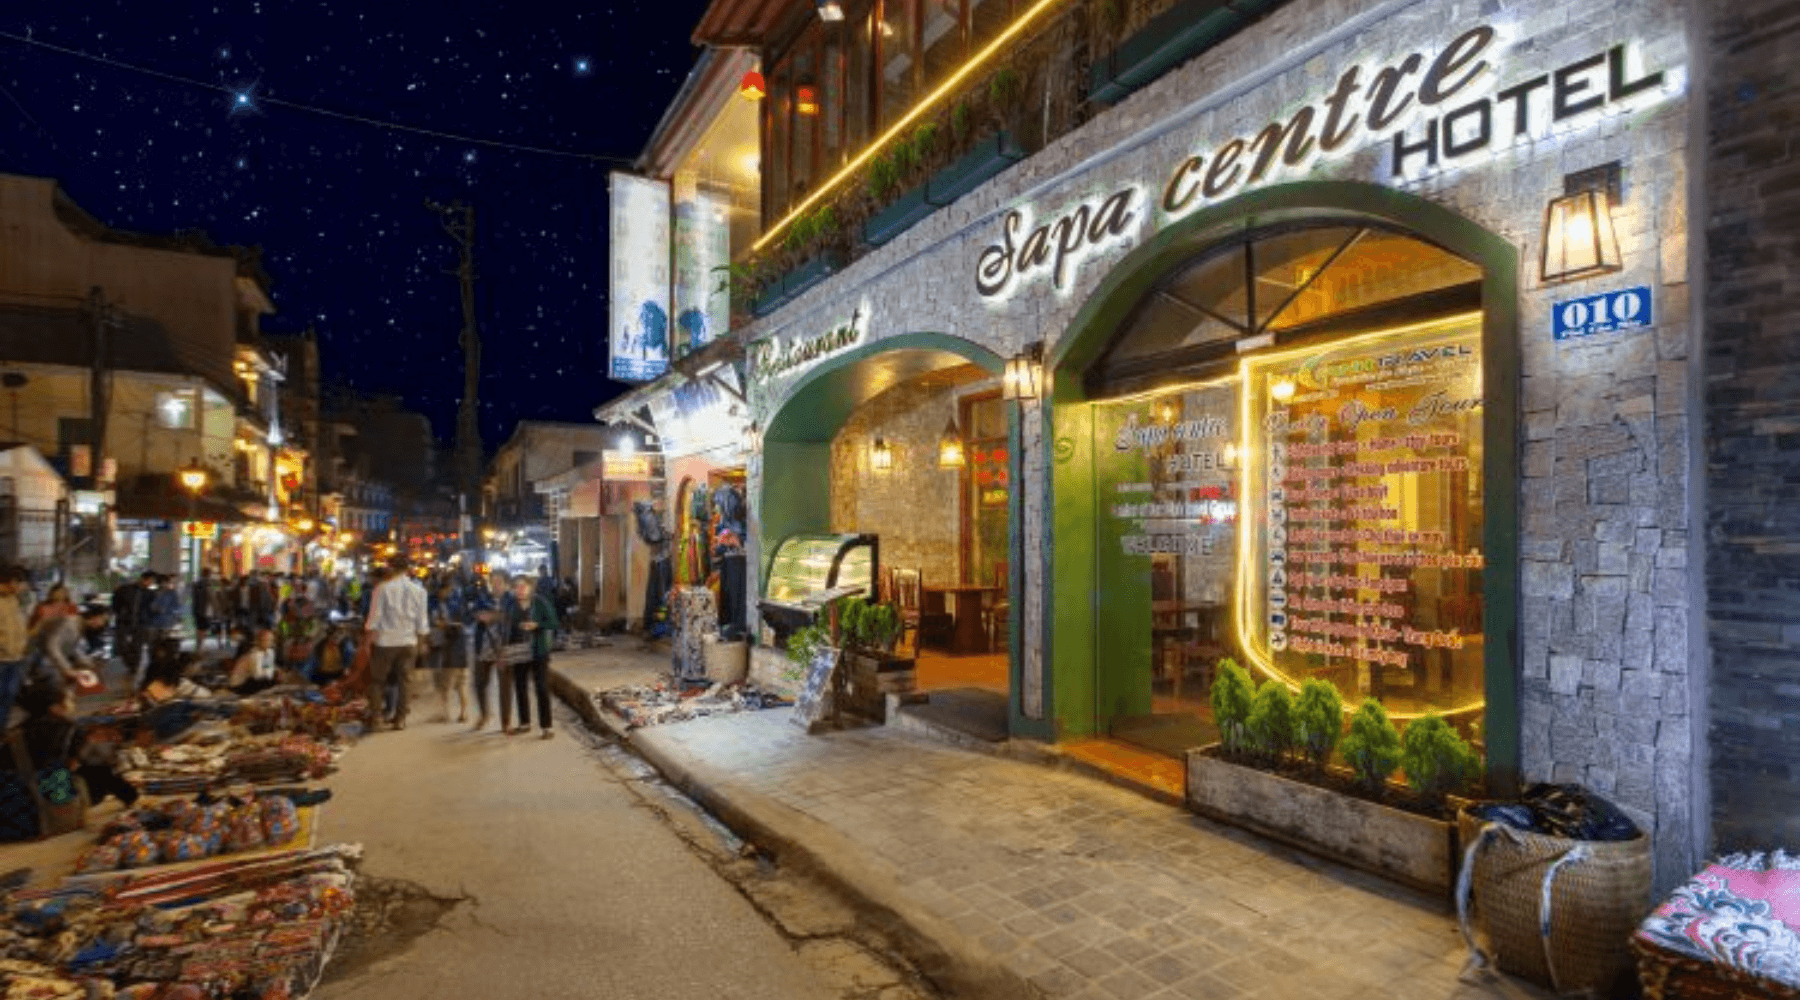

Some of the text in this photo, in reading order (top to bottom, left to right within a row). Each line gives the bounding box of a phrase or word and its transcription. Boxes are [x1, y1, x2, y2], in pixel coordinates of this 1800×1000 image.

[976, 26, 1494, 296] Sapa centre
[1392, 44, 1664, 176] HOTEL
[1562, 292, 1642, 330] 010
